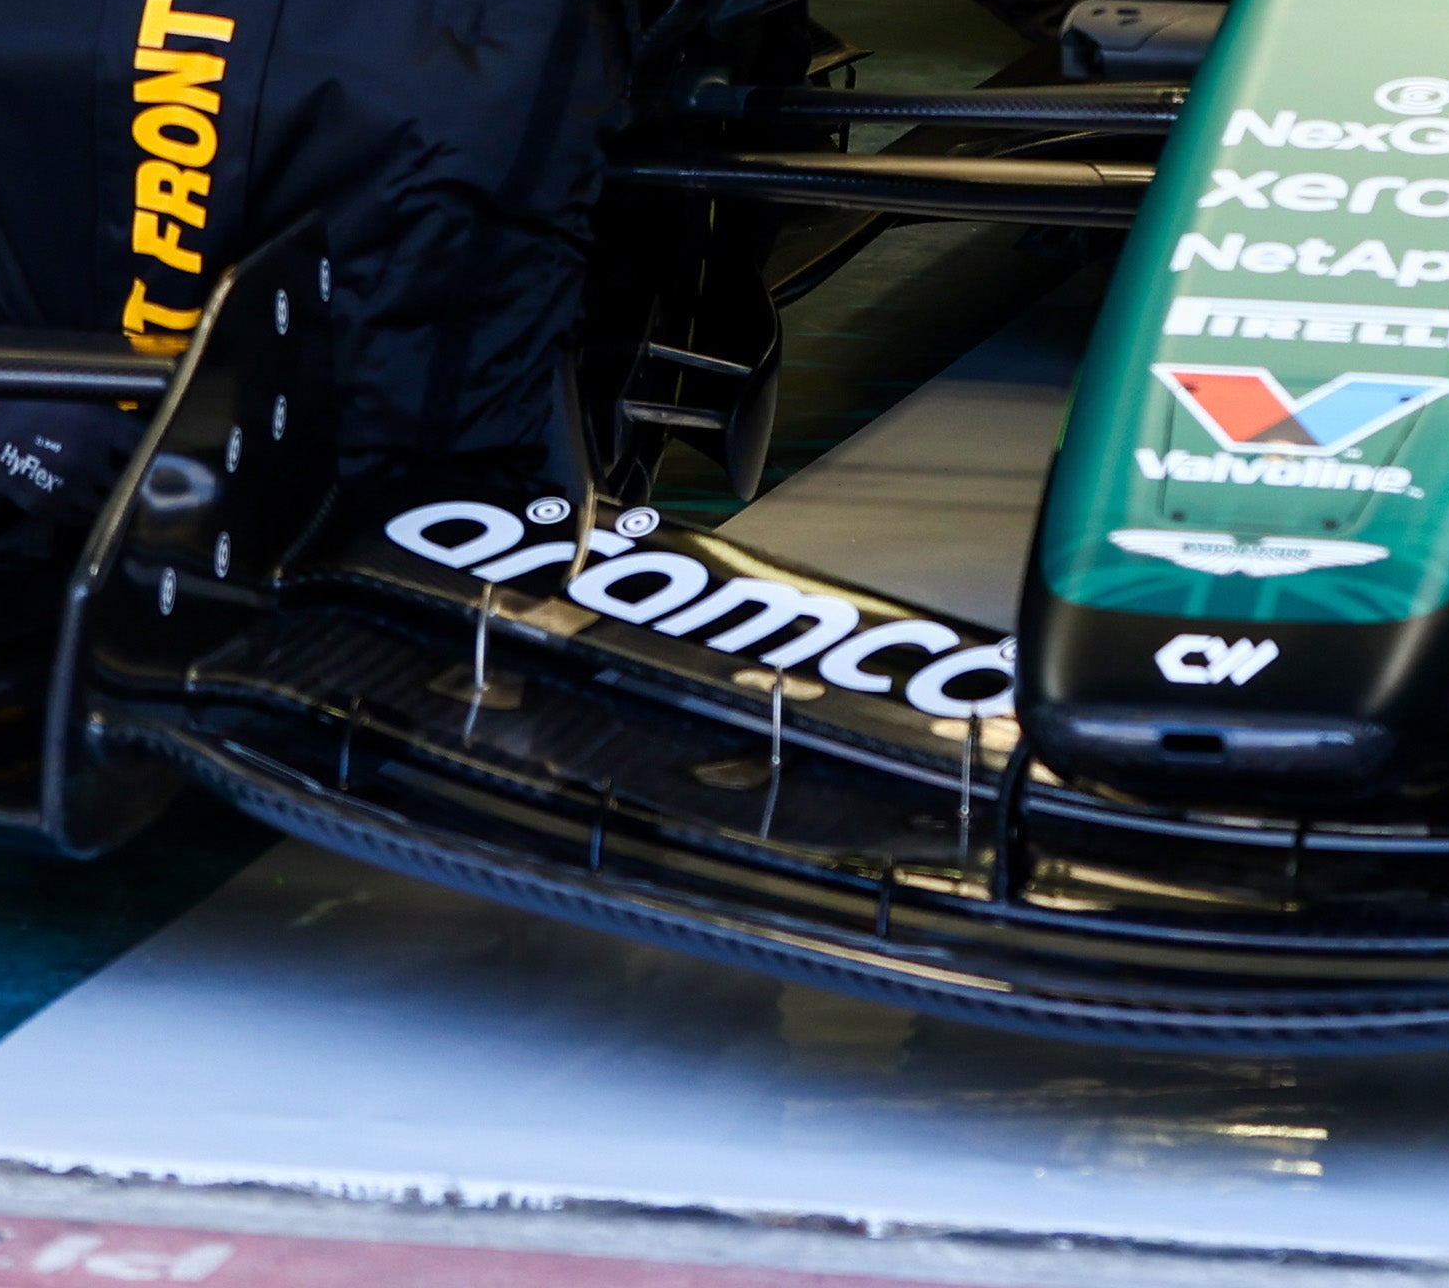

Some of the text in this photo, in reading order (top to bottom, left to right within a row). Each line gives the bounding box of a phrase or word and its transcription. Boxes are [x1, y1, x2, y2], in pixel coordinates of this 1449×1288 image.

[0, 441, 59, 493] HyFlex
[1135, 446, 1415, 496] Valvoline
[384, 499, 1016, 719] aramco
